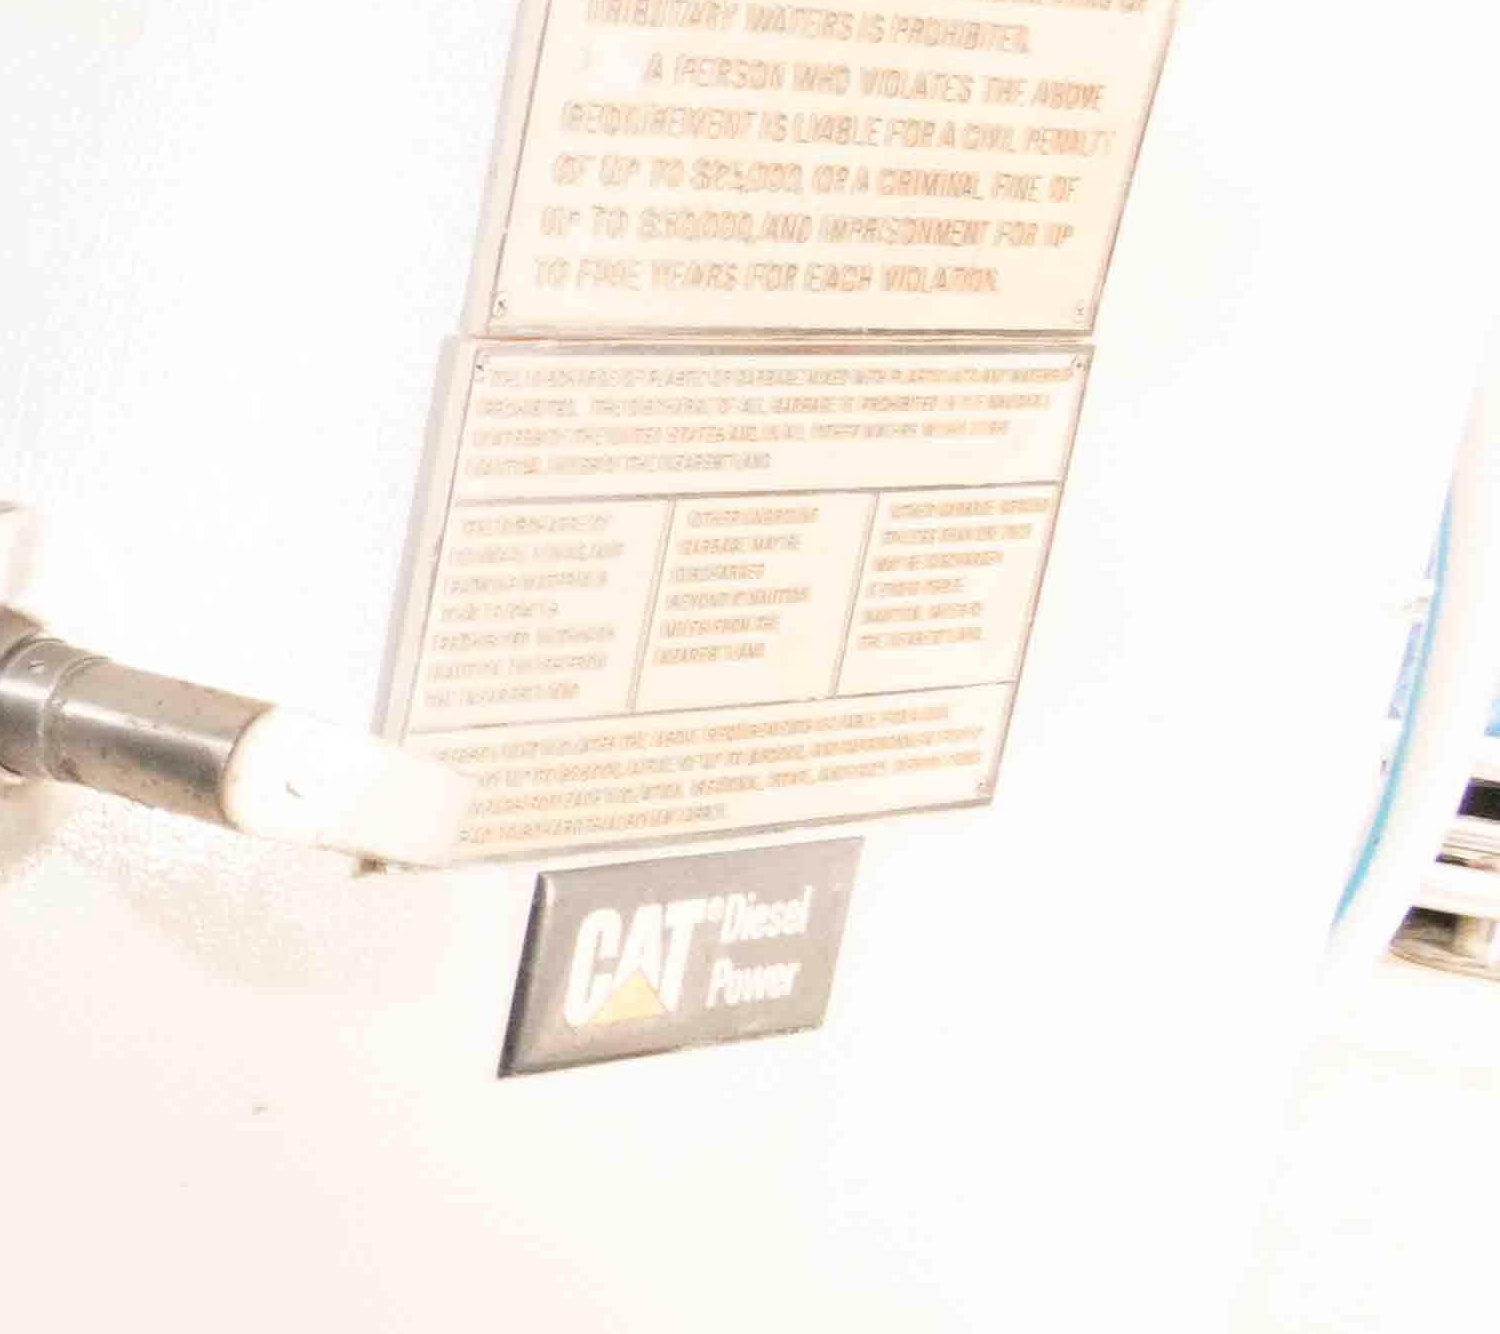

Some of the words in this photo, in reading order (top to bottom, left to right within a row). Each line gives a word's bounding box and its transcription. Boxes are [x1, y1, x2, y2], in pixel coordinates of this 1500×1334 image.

[645, 53, 664, 84] A
[938, 119, 959, 150] A
[563, 899, 707, 1027] CAT
[720, 886, 813, 945] Diesel
[705, 958, 801, 1010] Power
